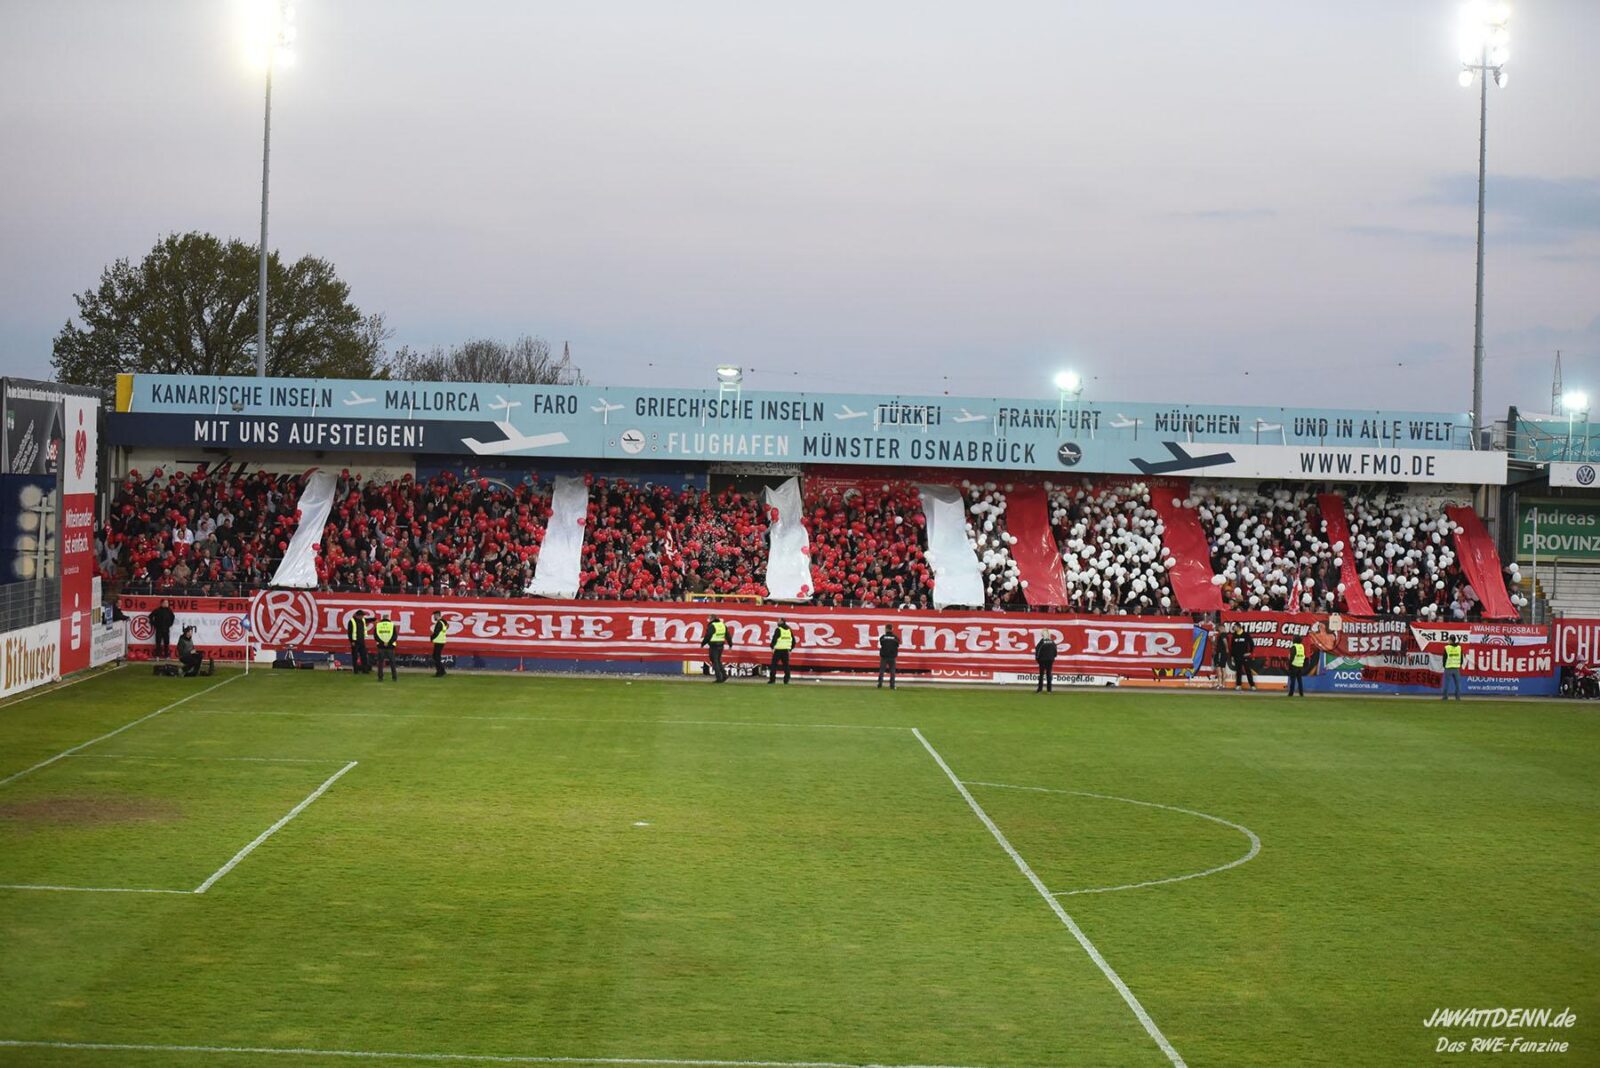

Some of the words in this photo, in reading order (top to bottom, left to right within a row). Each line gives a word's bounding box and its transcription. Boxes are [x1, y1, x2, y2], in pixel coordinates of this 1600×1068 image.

[152, 384, 262, 407] KANARISCHE
[270, 387, 332, 408] INSELN
[385, 390, 480, 412] MALLORCA
[534, 394, 578, 414] FARO
[635, 397, 753, 419] GRIECHISCHE
[761, 401, 824, 421] INSELN
[879, 401, 941, 426] TÜRKEI
[999, 407, 1101, 430] FRANKFURT
[194, 420, 230, 442] MIT
[239, 421, 279, 443] UNS
[289, 422, 424, 447] AUFSTEIGEN!
[1155, 410, 1240, 434] MÜNCHEN
[1294, 418, 1327, 437] UND
[1336, 419, 1353, 438] IN
[1360, 420, 1402, 440] ALLE
[1409, 421, 1453, 442] WELT
[668, 432, 789, 456] FLUGHAFEN
[803, 433, 900, 458] MÜNSTER
[911, 438, 1036, 464] OSNABRÜCK
[1300, 453, 1436, 476] WWW.FMO.DE
[1524, 508, 1596, 526] Andreas
[124, 598, 146, 609] Die
[1281, 623, 1310, 637] CREW
[1473, 625, 1501, 633] WAHRE
[1502, 626, 1540, 634] FUSSBALL
[1347, 635, 1402, 652] ESSEN
[4, 635, 56, 690] Bitburger
